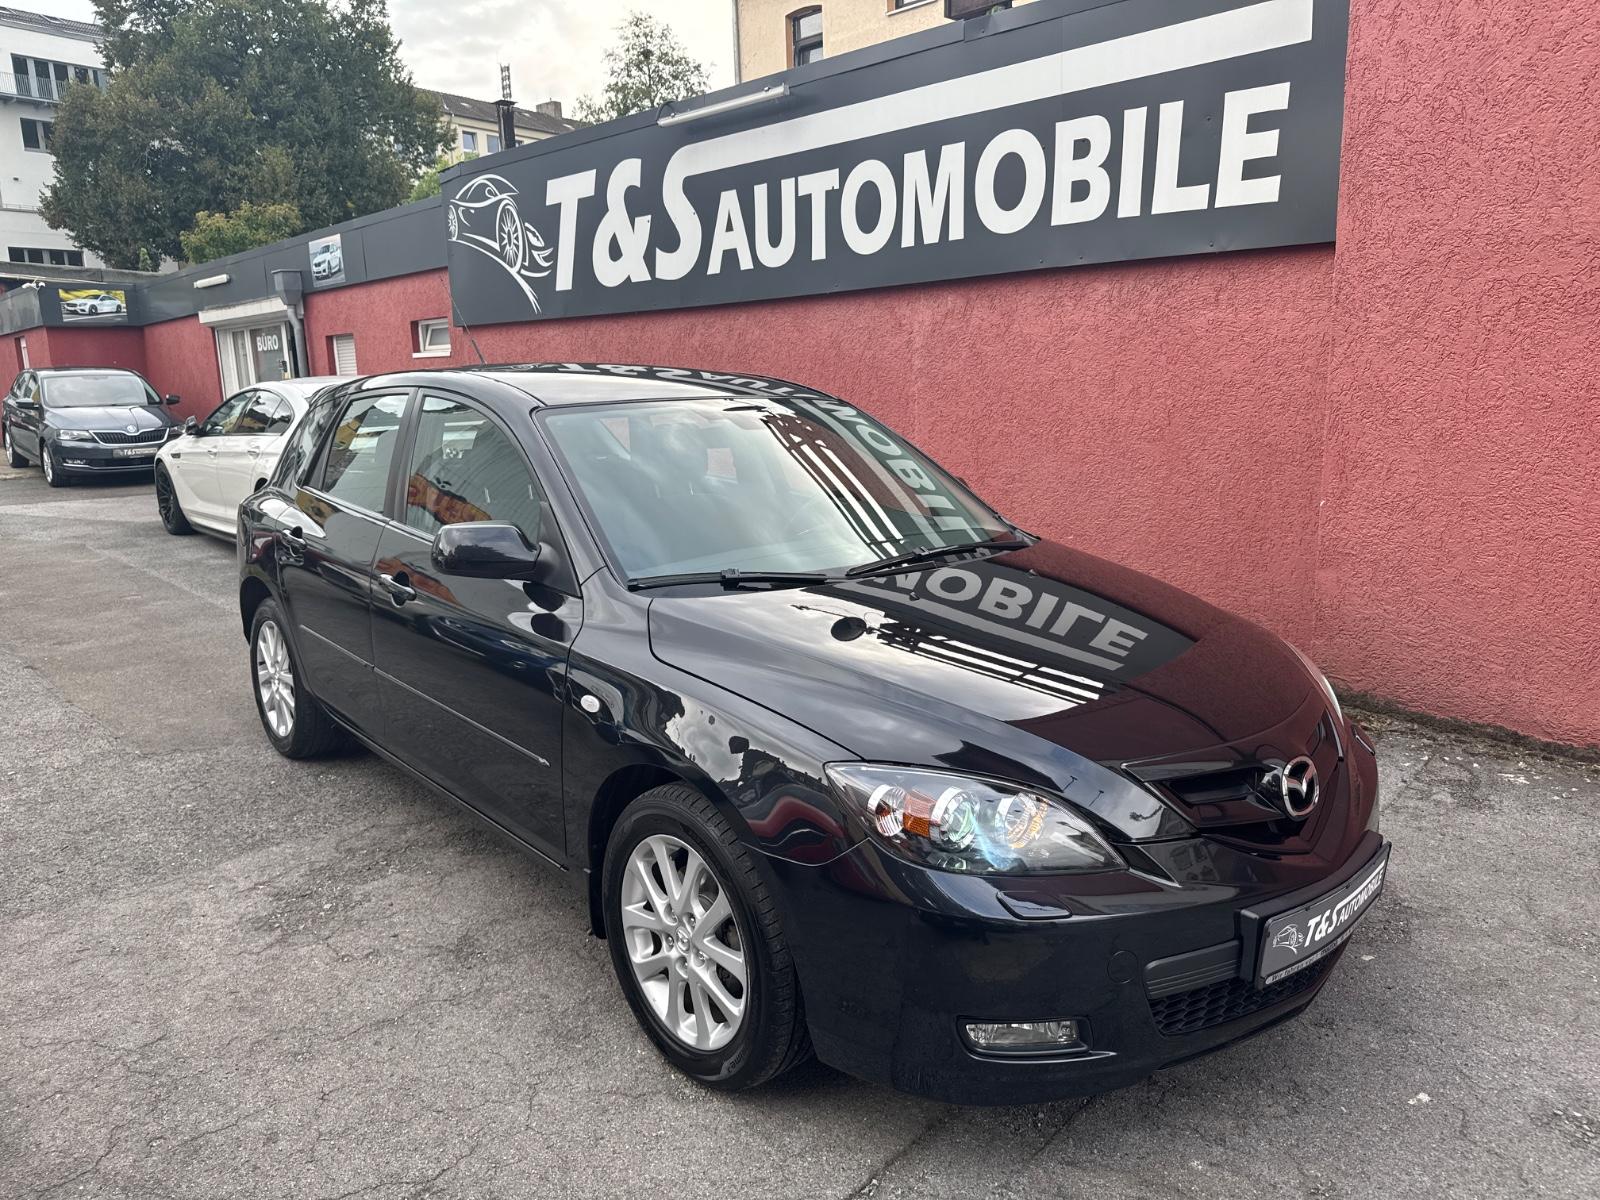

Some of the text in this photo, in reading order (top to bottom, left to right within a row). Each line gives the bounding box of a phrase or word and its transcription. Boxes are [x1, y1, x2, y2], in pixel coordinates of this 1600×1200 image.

[545, 82, 1291, 292] T&S AUTOMOBILE
[256, 333, 279, 351] BÜRO
[1303, 904, 1340, 948] T&S
